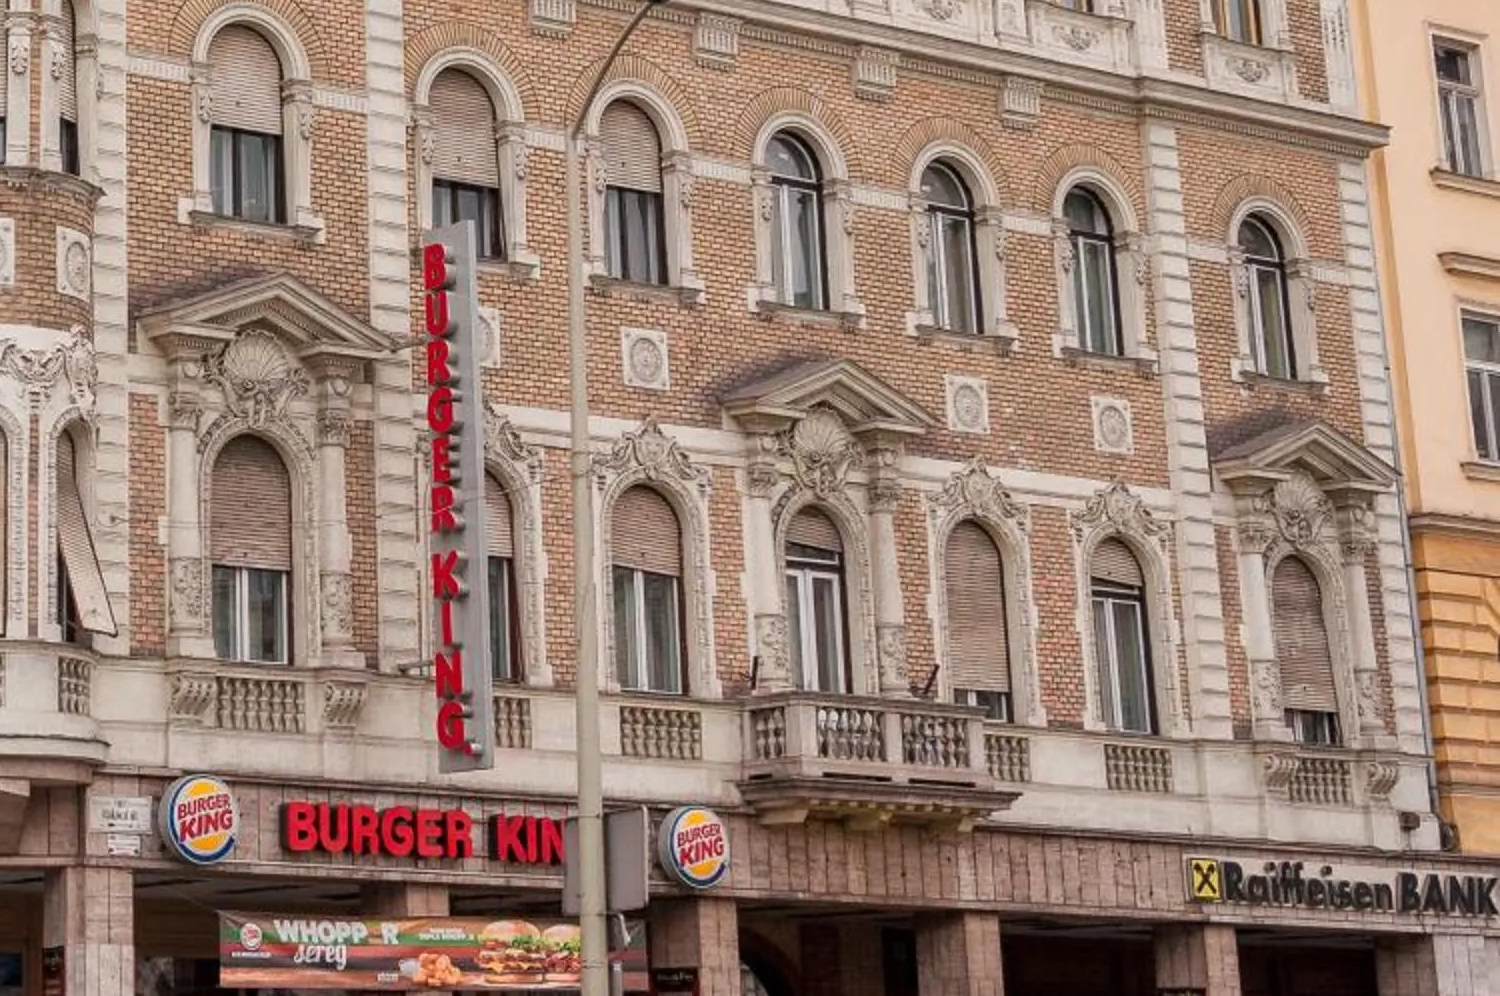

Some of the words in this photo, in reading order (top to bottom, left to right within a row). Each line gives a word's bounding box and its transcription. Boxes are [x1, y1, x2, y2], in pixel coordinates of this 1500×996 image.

[424, 244, 455, 535] BURGER
[431, 550, 474, 757] KING
[178, 794, 230, 820] BURGER
[180, 809, 233, 842] KING
[286, 801, 474, 859] BURGER
[495, 811, 565, 864] KIN
[677, 824, 721, 847] BURGER
[680, 836, 724, 867] KING
[1220, 861, 1393, 911] Raiffeisen
[1395, 871, 1499, 915] BANK
[273, 919, 399, 944] WHOPPR
